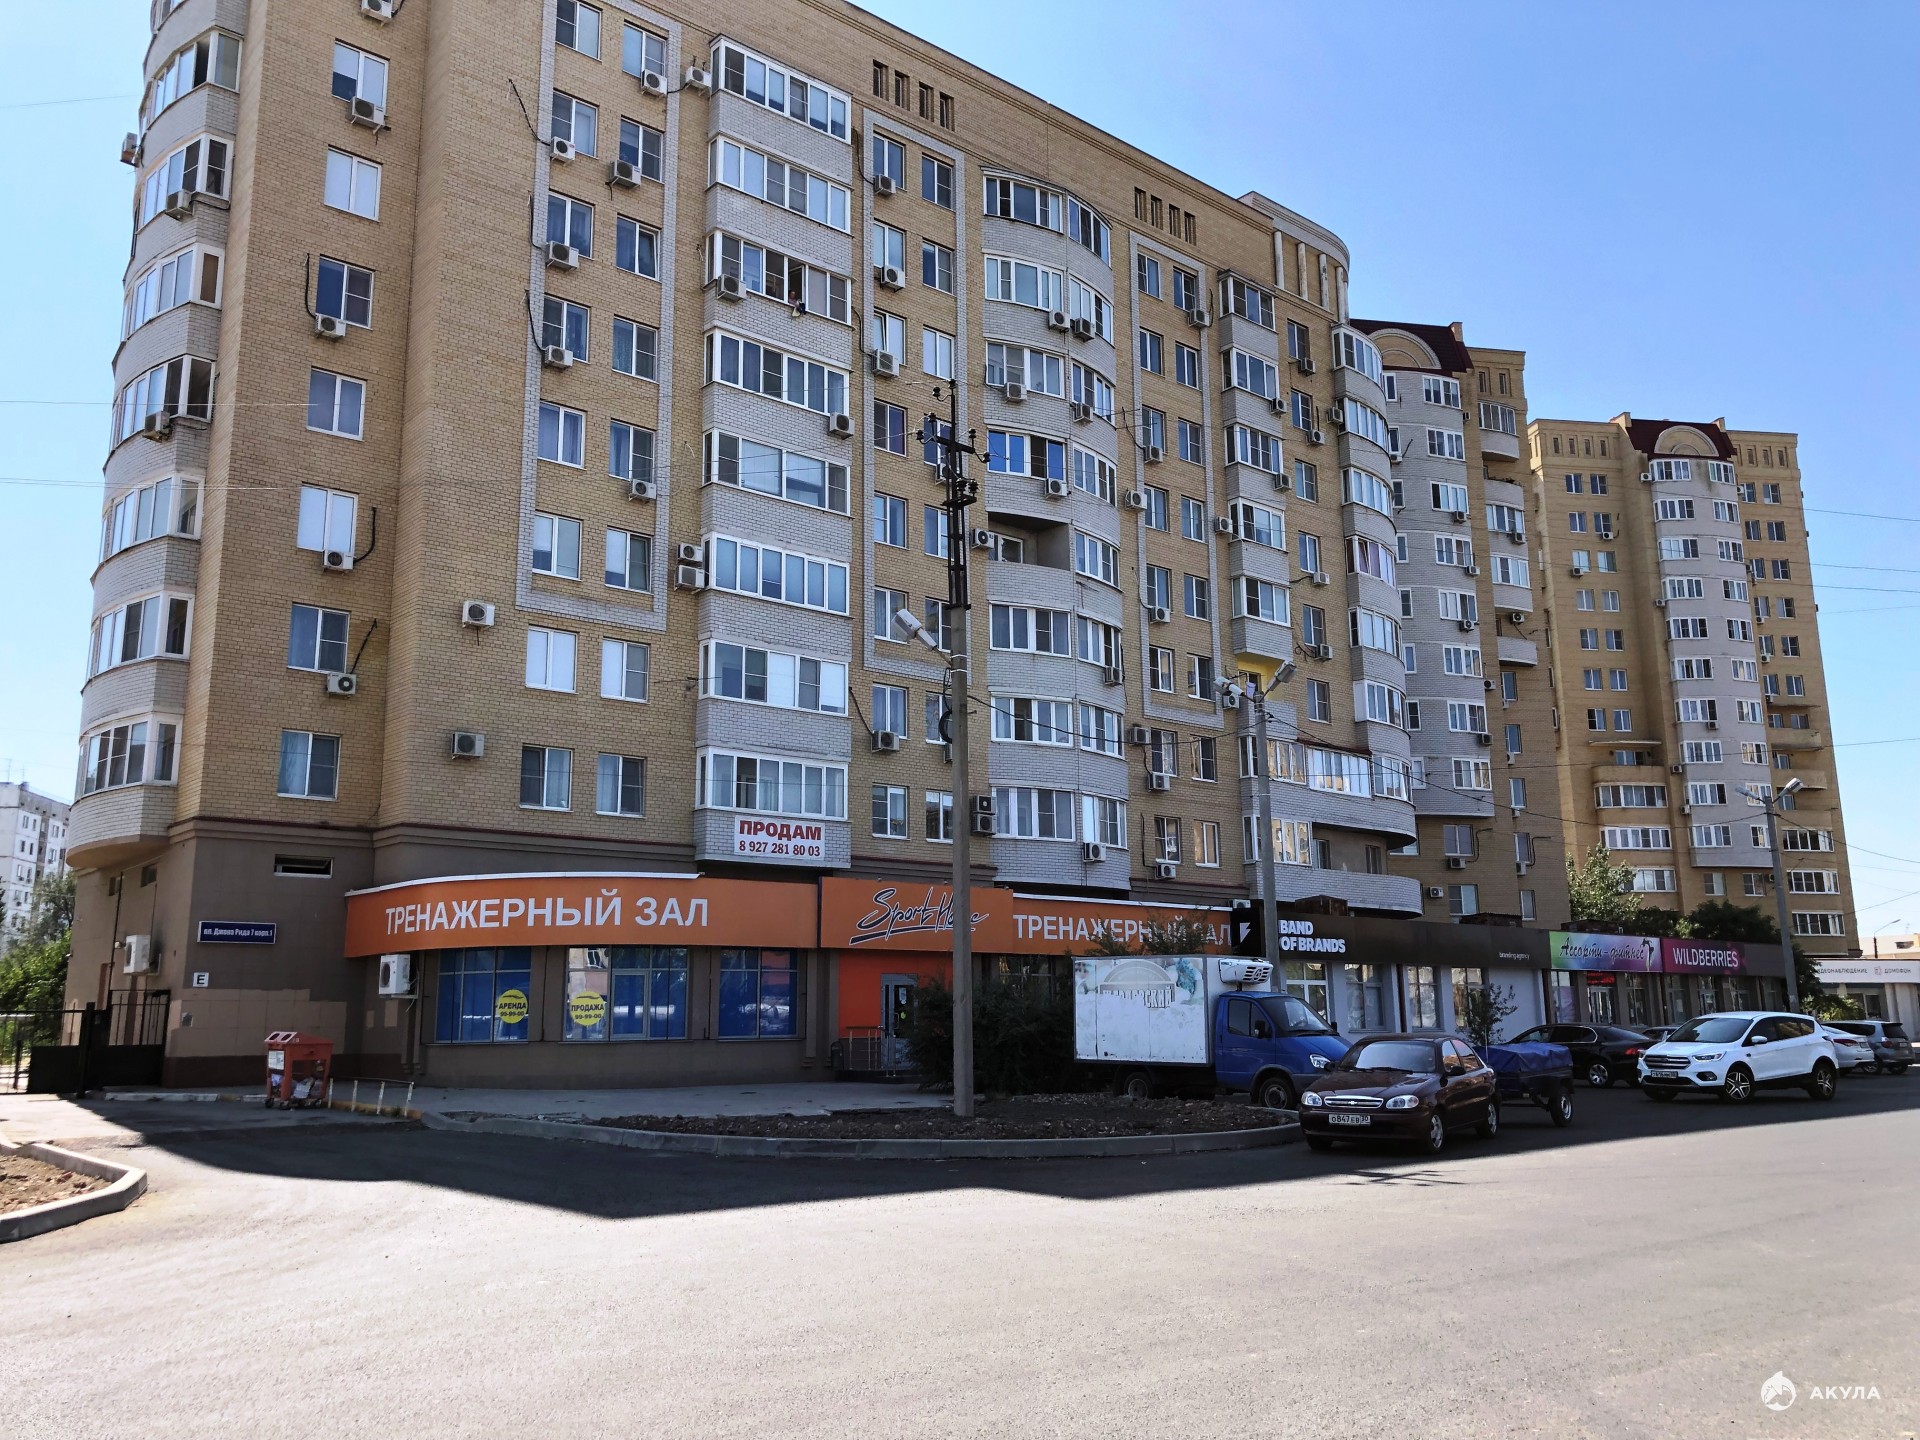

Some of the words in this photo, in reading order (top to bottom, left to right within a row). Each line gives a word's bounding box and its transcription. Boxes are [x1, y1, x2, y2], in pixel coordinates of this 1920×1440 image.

[739, 820, 822, 841] ПРОДАМ
[739, 840, 746, 851] 8
[749, 841, 768, 852] 927
[771, 843, 789, 854] 281
[793, 844, 806, 855] 80
[808, 846, 820, 857] 03
[385, 888, 622, 935] ТРЕНАЖЕРНЫЙ
[634, 896, 708, 927] ЗАЛ
[856, 886, 940, 941] Sport
[1279, 919, 1314, 935] BAND
[1280, 936, 1297, 951] OF
[1298, 937, 1346, 953] BRANDS
[1673, 947, 1739, 967] WILDBERRIES
[498, 1002, 527, 1010] АРЕНДА
[571, 1003, 605, 1012] ПРОДАЖА
